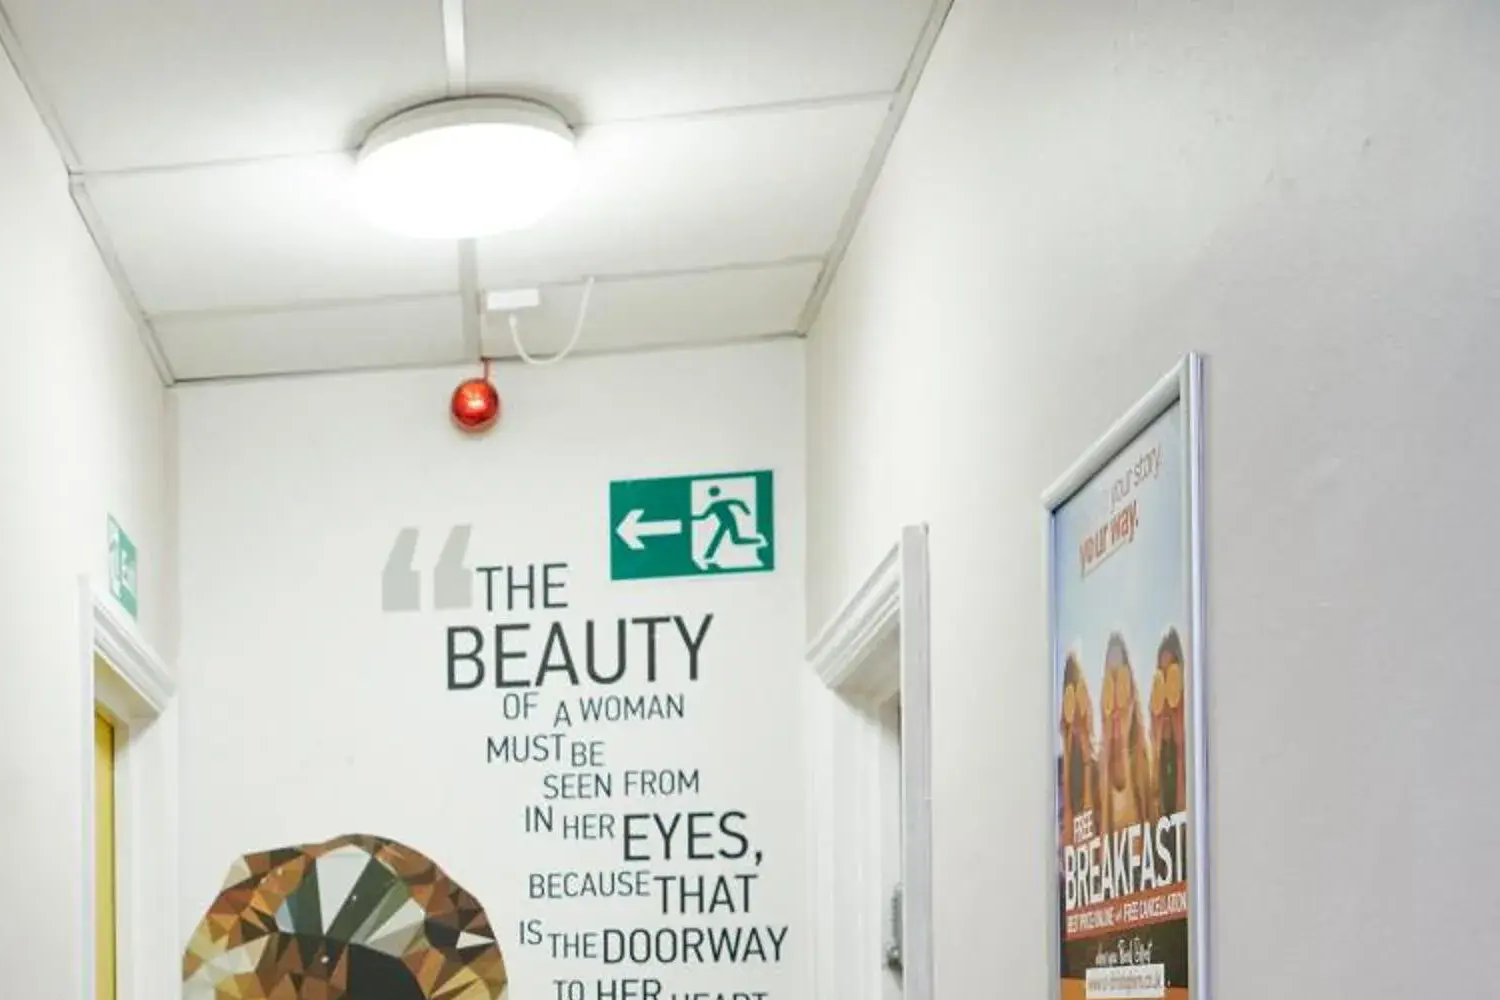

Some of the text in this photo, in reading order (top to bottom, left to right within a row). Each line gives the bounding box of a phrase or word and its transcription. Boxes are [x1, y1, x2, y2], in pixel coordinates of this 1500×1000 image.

[476, 563, 568, 611] THE
[446, 614, 714, 690] BEAUTY
[502, 691, 685, 729] OF A WOMAN
[486, 732, 605, 769] MUST BE
[543, 767, 700, 801] SEEN FROM
[524, 804, 764, 868] IN HER EYES,
[1073, 812, 1093, 843] FREE
[1064, 812, 1188, 910] BREAKFAST
[528, 869, 760, 916] BECAUSE THAT
[518, 918, 789, 966] IS THE DOORWAY
